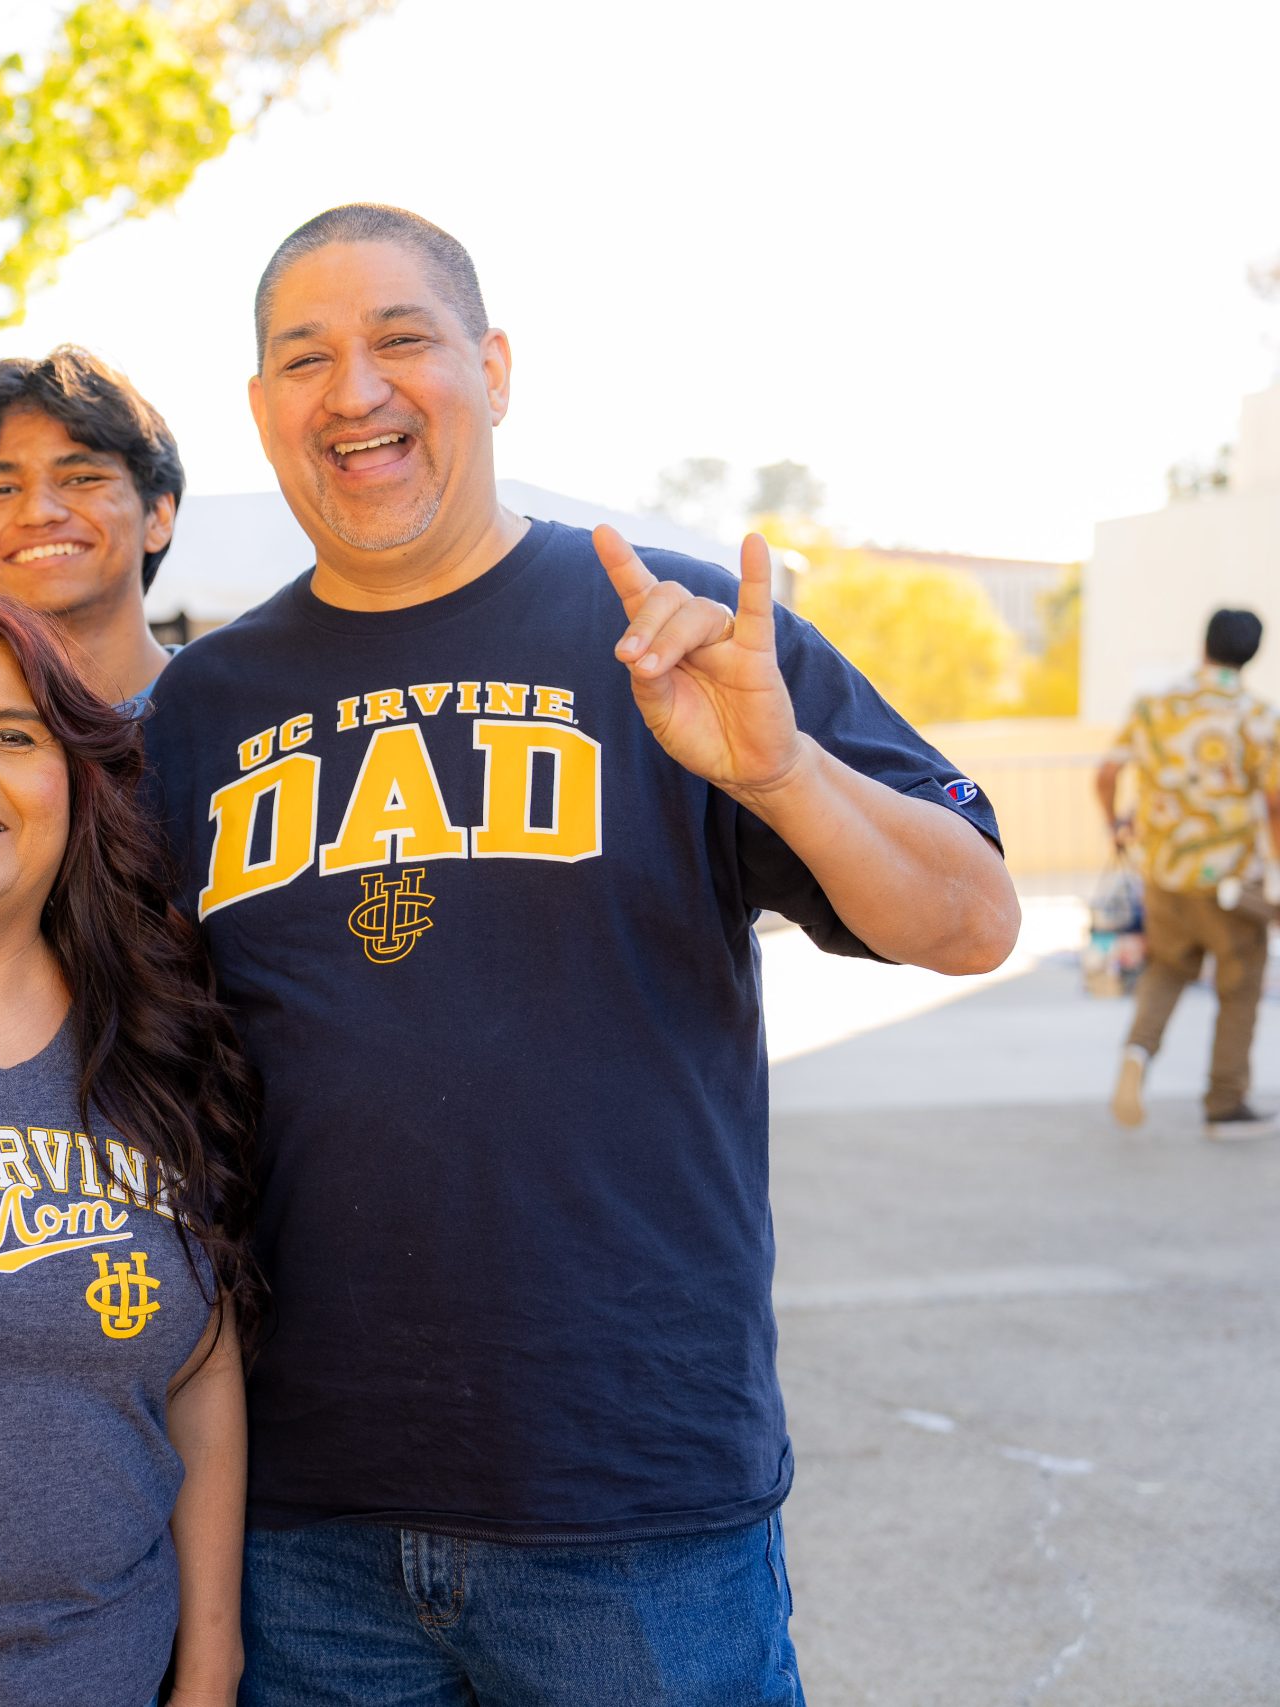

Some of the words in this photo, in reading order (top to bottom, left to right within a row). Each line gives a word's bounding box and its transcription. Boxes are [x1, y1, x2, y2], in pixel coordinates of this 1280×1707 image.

[238, 713, 313, 771] UC
[337, 681, 574, 732] IRVINE
[199, 719, 602, 923] DAD
